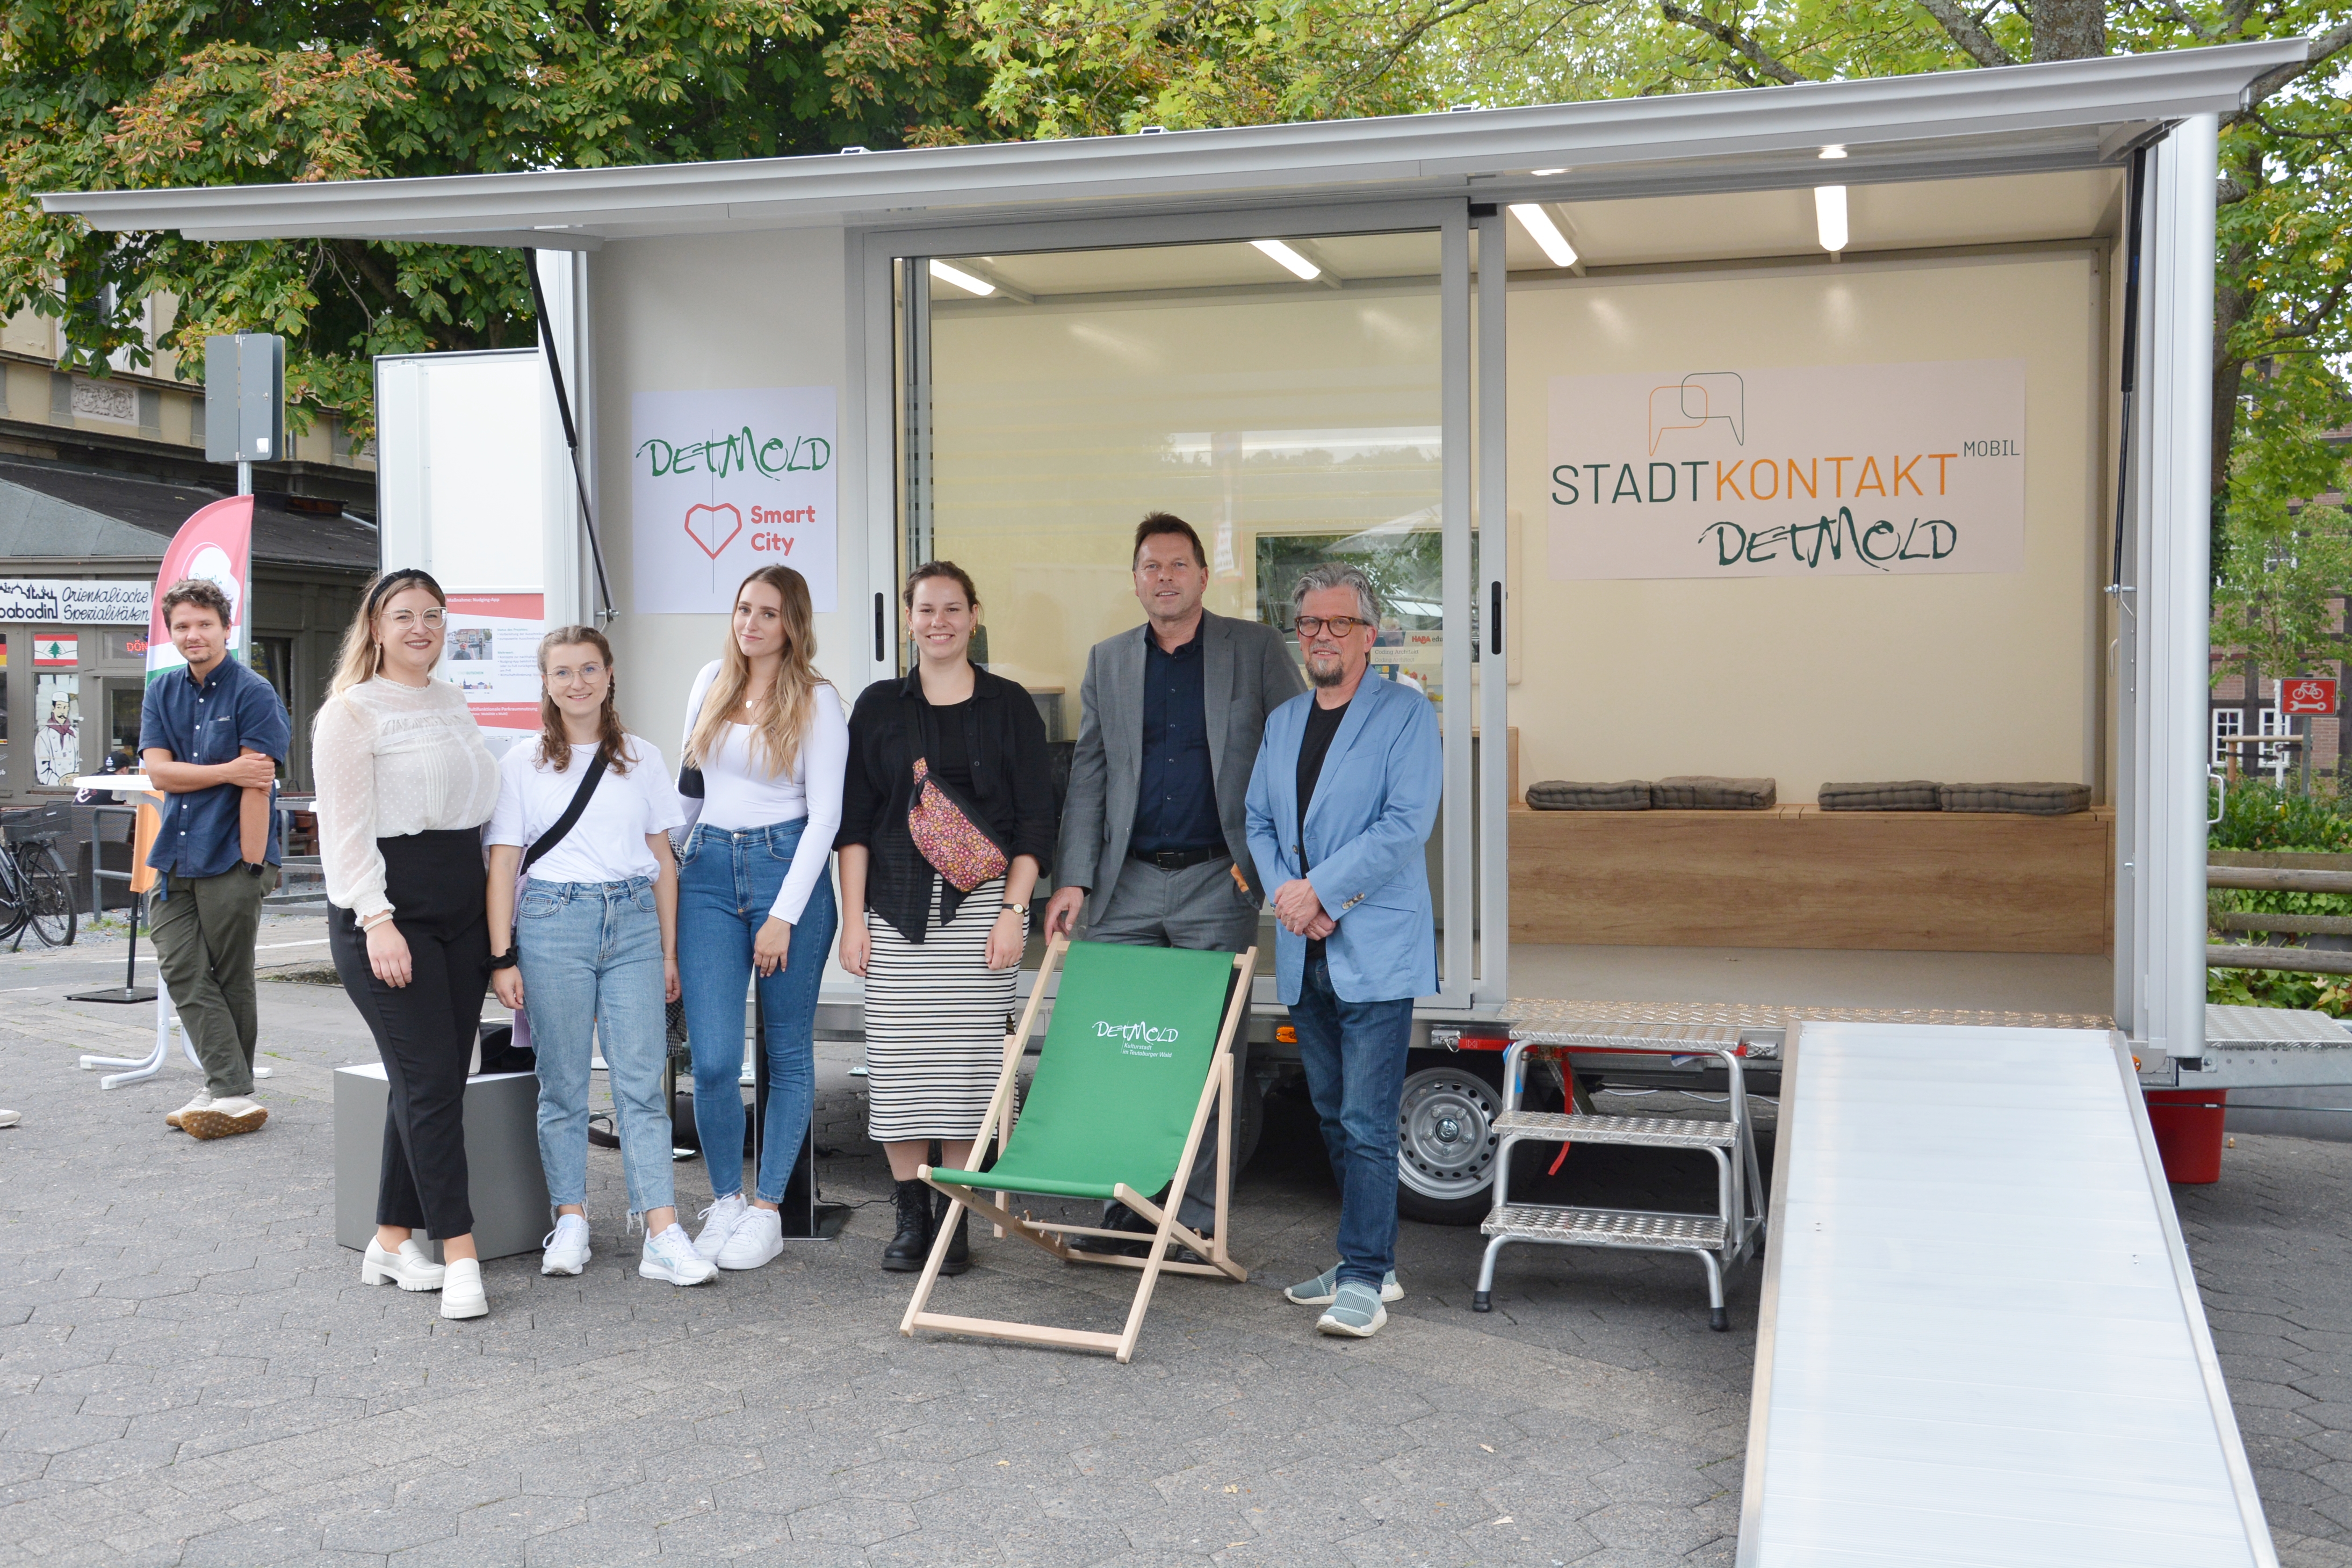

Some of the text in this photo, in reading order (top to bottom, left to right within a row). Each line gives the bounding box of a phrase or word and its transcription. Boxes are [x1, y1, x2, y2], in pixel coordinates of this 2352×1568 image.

[1964, 439, 2020, 458] MOBIL
[751, 505, 816, 524] Smart
[751, 532, 795, 556] City
[62, 587, 149, 603] Orientalische
[64, 604, 149, 622] Spezialitäten
[1411, 635, 1432, 645] HABA
[1124, 1043, 1152, 1051] Kulturstadt
[1129, 1050, 1158, 1058] Teutoburger
